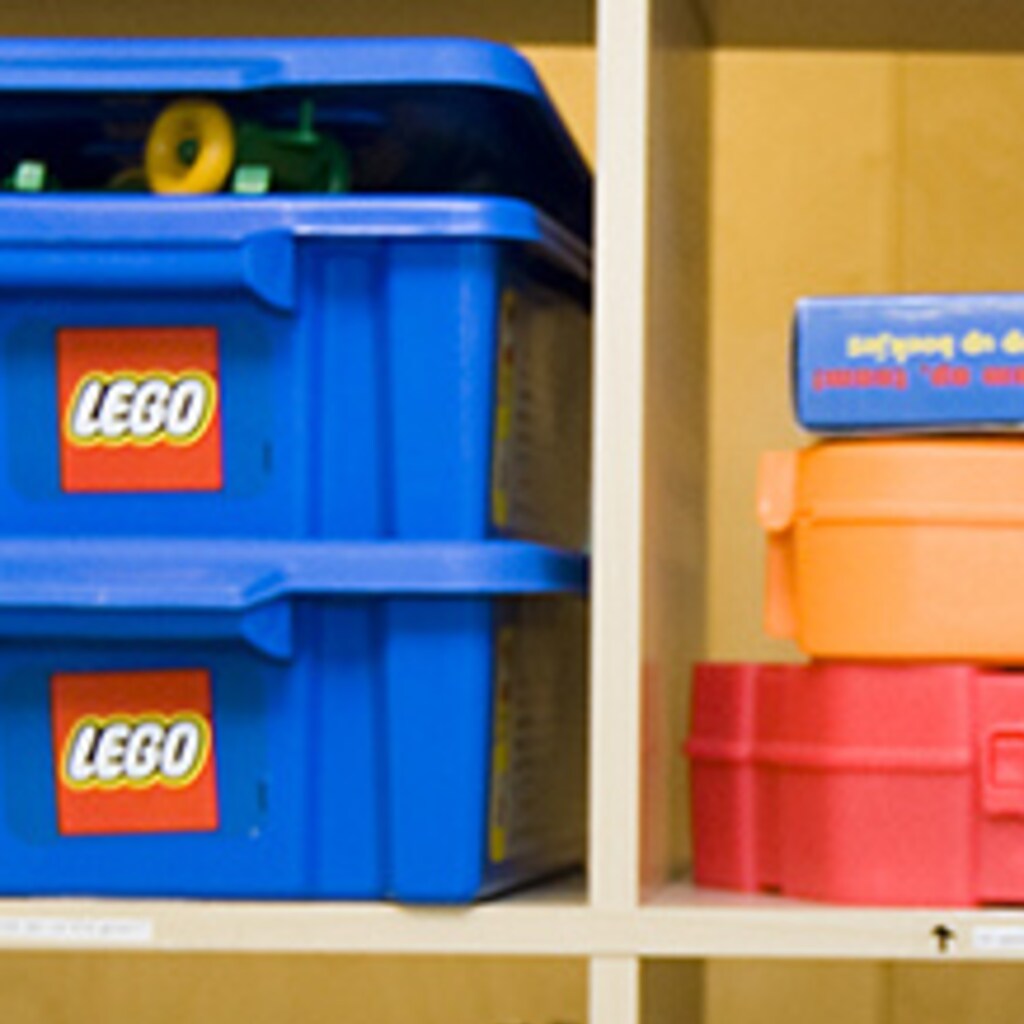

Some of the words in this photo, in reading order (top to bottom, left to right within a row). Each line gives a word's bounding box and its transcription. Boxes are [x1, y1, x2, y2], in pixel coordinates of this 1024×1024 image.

[961, 331, 995, 358] up
[68, 374, 214, 443] LEGO
[63, 714, 208, 787] LEGO
